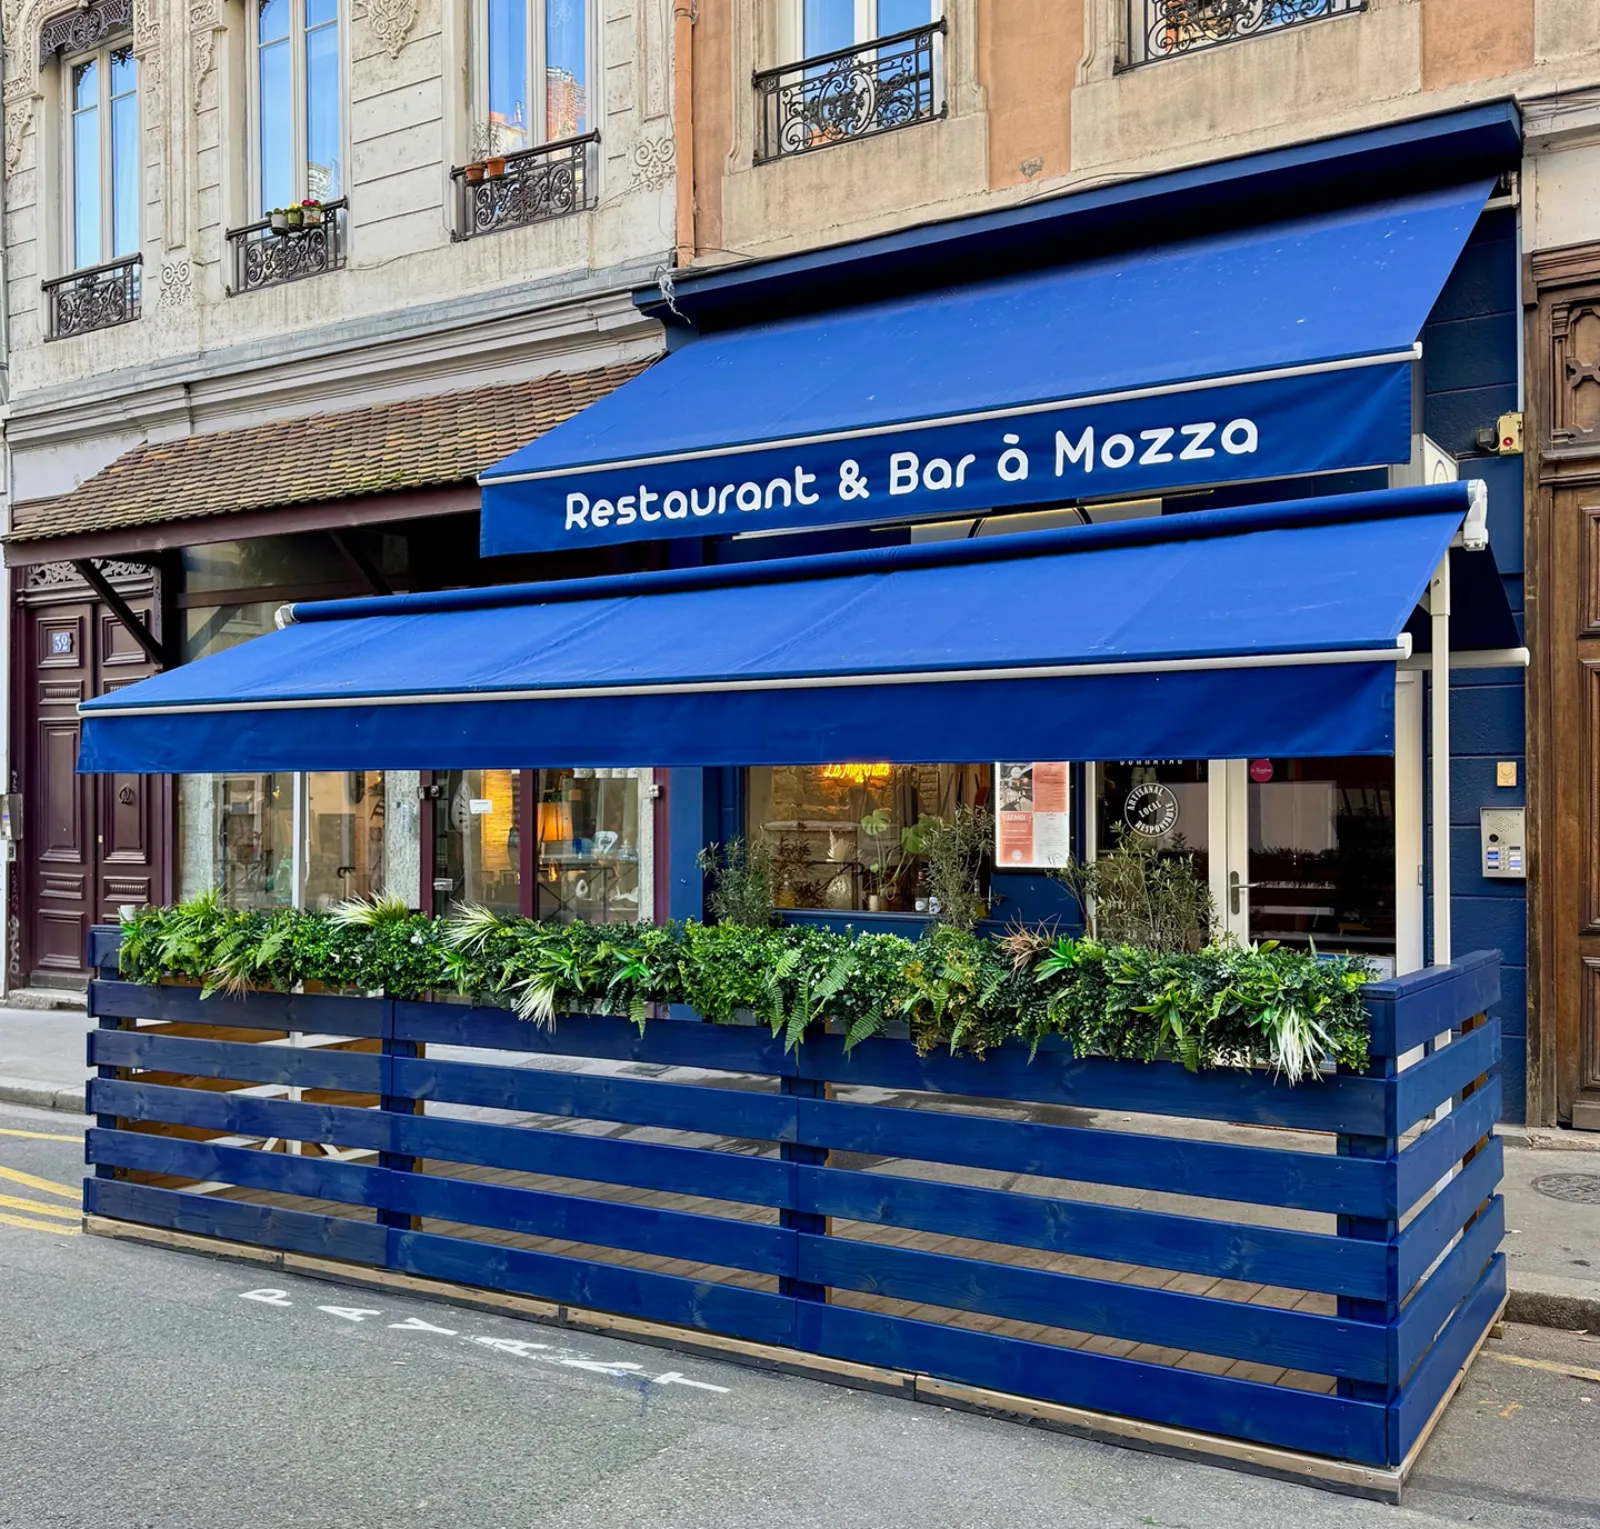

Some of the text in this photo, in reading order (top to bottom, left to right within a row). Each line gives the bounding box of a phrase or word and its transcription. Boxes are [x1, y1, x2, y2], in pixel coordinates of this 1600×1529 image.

[565, 418, 1258, 530] Restaurant & Bar à Mozza
[1127, 785, 1164, 811] ARTISANAL
[1139, 800, 1162, 818] LOCAL
[1135, 802, 1174, 834] RESPONSABLE
